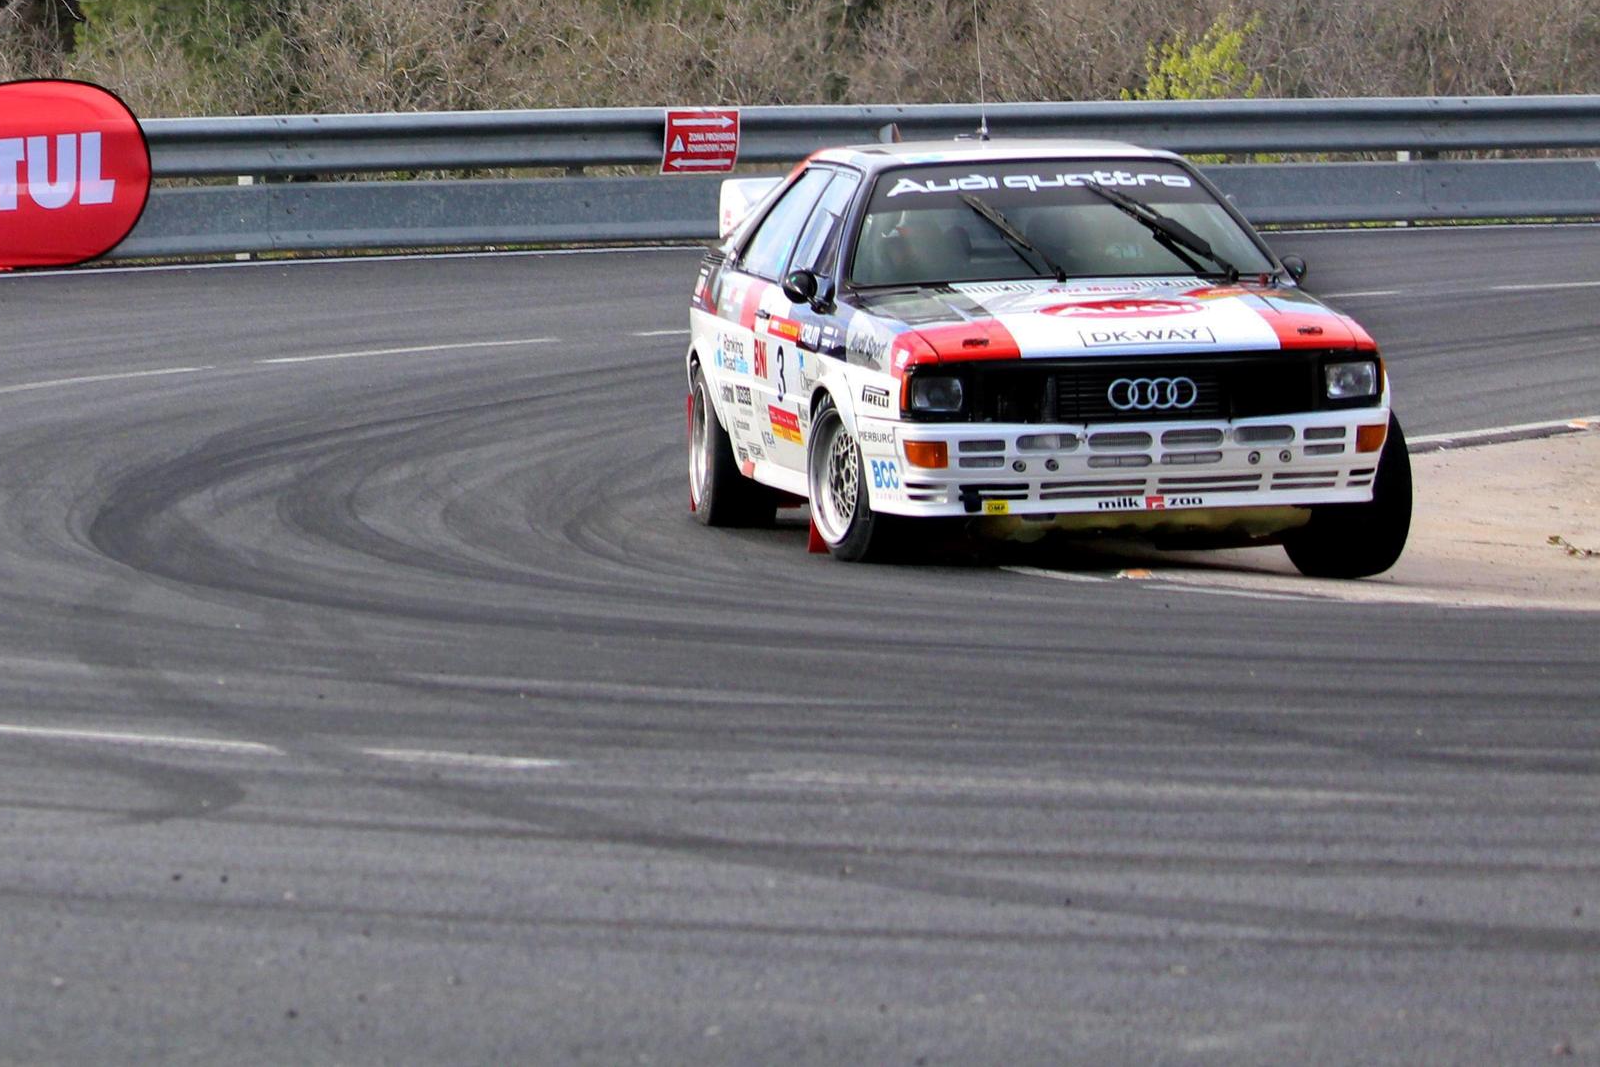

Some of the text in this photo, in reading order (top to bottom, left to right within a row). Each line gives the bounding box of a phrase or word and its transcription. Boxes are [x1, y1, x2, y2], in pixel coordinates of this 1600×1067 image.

[886, 170, 1191, 197] Audi quattro
[1091, 329, 1199, 344] DK-WAY
[776, 345, 787, 402] 3
[862, 384, 890, 409] PIRELLI
[870, 459, 899, 489] BCC
[1098, 497, 1139, 510] milk
